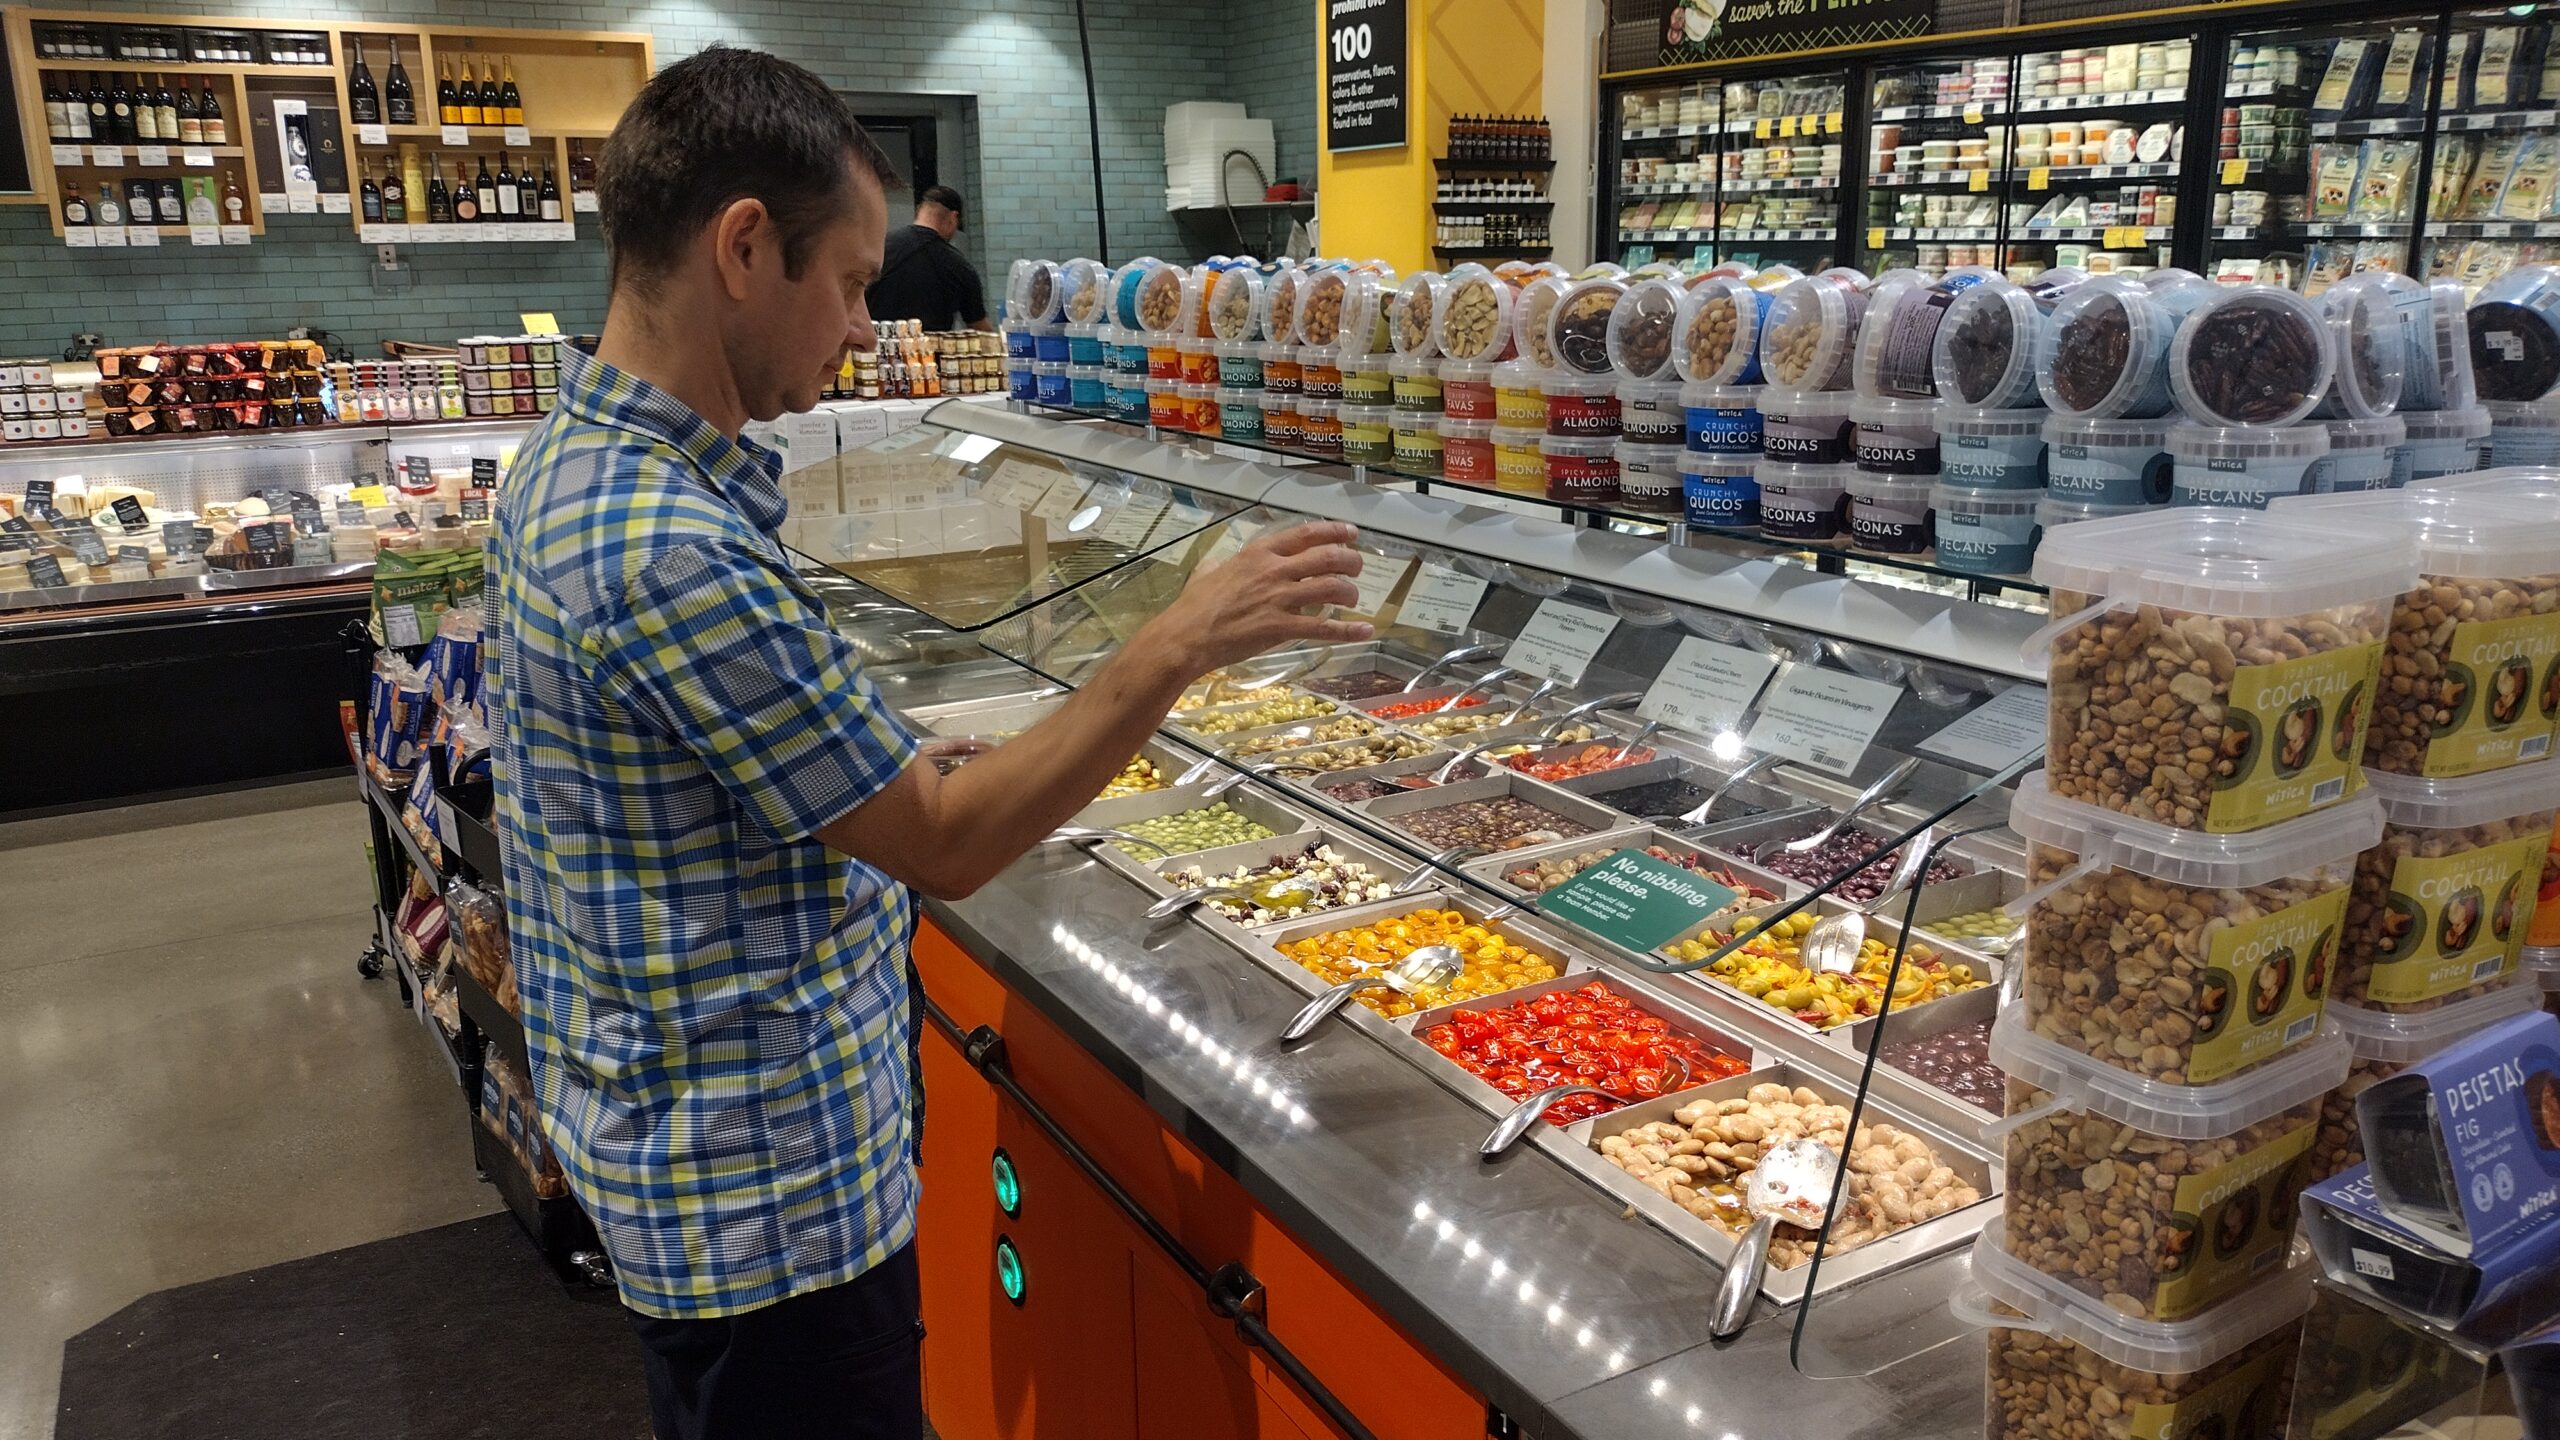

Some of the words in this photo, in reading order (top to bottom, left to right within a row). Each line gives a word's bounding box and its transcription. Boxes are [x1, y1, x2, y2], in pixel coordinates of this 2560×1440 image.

[1728, 5, 1775, 23] savor
[1778, 0, 1806, 15] the
[1331, 23, 1371, 63] 100
[1332, 69, 1372, 85] preservatives,
[1372, 64, 1396, 77] flavors,
[1332, 86, 1350, 99] colors
[1351, 84, 1357, 97] &
[1358, 83, 1374, 95] other
[1332, 101, 1365, 115] ingredients
[1366, 94, 1399, 110] commonly
[1332, 118, 1350, 130] found
[1351, 116, 1358, 127] in
[1358, 114, 1373, 126] food
[1447, 401, 1475, 411] FAVAS
[1623, 423, 1677, 434] ALMONDS
[1705, 422, 1755, 431] CRUNCHY
[1700, 430, 1758, 444] QUICOS
[1447, 457, 1474, 467] FAVAS
[1945, 461, 2006, 477] PECANS
[1565, 476, 1619, 488] ALMOND
[2049, 473, 2106, 491] PECANS
[464, 489, 483, 498] LOCAL
[1693, 488, 1738, 497] CRUNCHY
[2187, 486, 2266, 505] PECANS
[1690, 496, 1743, 511] QUICOS
[1939, 536, 1998, 555] PECANS
[2472, 638, 2558, 666] COCKTAIL
[2256, 671, 2350, 712] COCKTAIL
[1662, 703, 1678, 716] 170
[1774, 732, 1791, 745] 160
[1589, 869, 1649, 900] please.
[1611, 857, 1639, 875] No
[1637, 869, 1709, 908] nibbling,
[2419, 863, 2509, 900] COCKTAIL
[1565, 888, 1592, 904] sample,
[1590, 900, 1618, 914] please
[1616, 911, 1632, 920] ask
[1574, 882, 1585, 890] If
[1580, 884, 1597, 895] you
[1595, 891, 1619, 904] would
[1614, 900, 1629, 910] like
[1563, 895, 1583, 908] Team
[1580, 904, 1611, 922] Member.
[2231, 918, 2321, 968] COCKTAIL
[2445, 1056, 2526, 1118] PESETAS
[2455, 1118, 2480, 1143] FIG
[2199, 1158, 2286, 1209] COCKTAIL
[2355, 1260, 2391, 1277] $10.99
